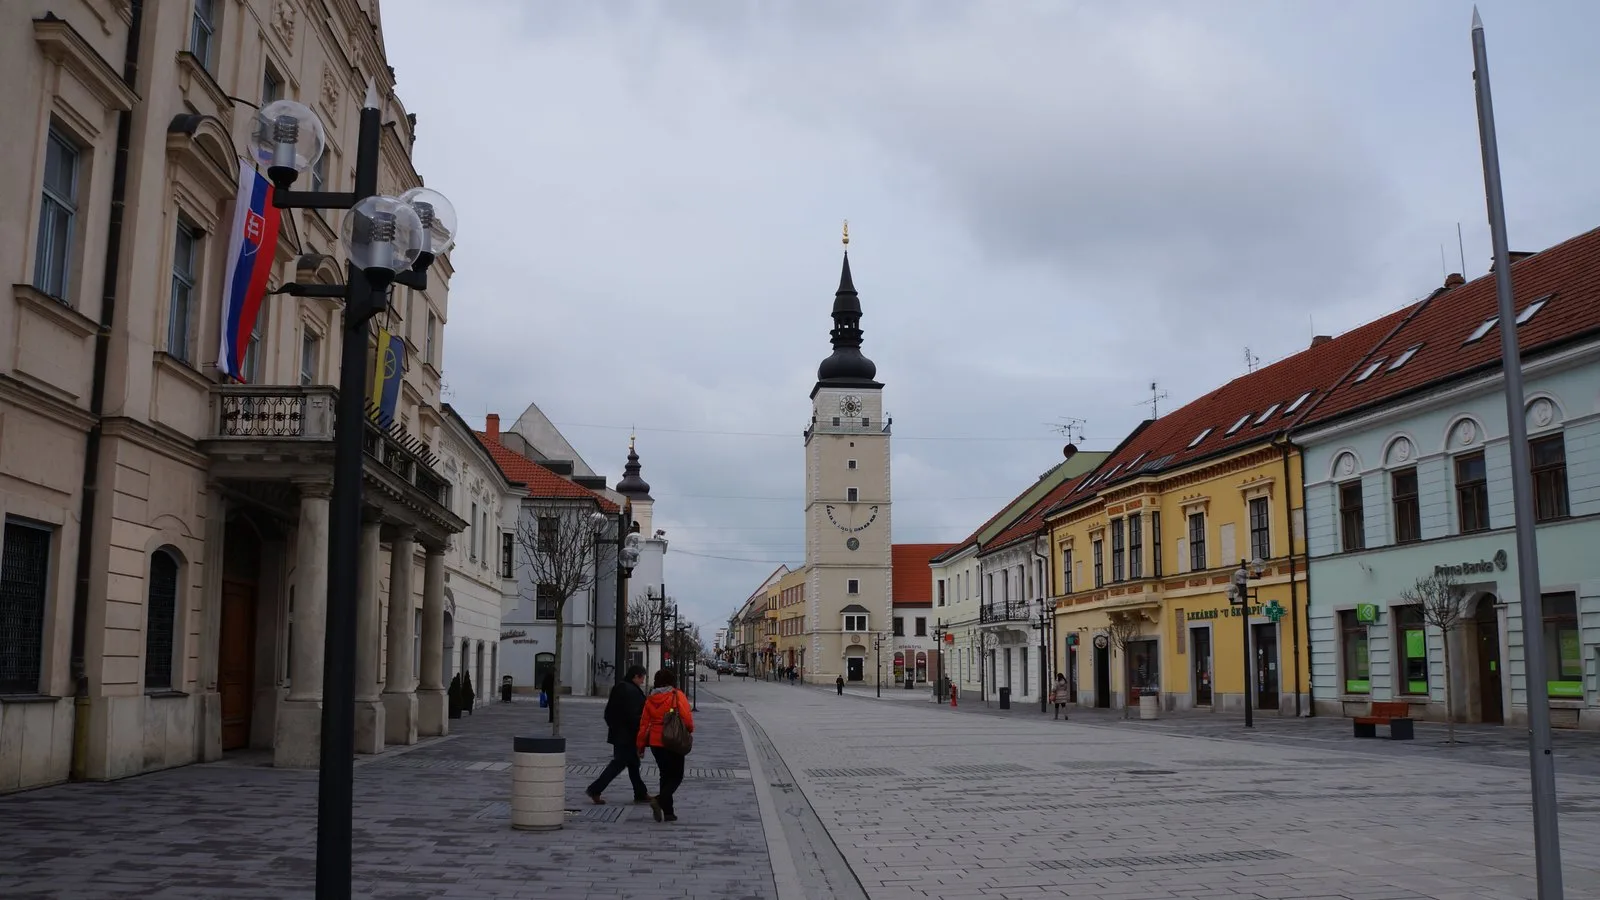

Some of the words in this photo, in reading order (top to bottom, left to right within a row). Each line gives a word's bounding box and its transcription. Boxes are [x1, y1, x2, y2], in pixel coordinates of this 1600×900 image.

[1435, 564, 1462, 576] Prima
[1462, 560, 1494, 575] Banka
[1187, 608, 1218, 620] LEKÁREŇ
